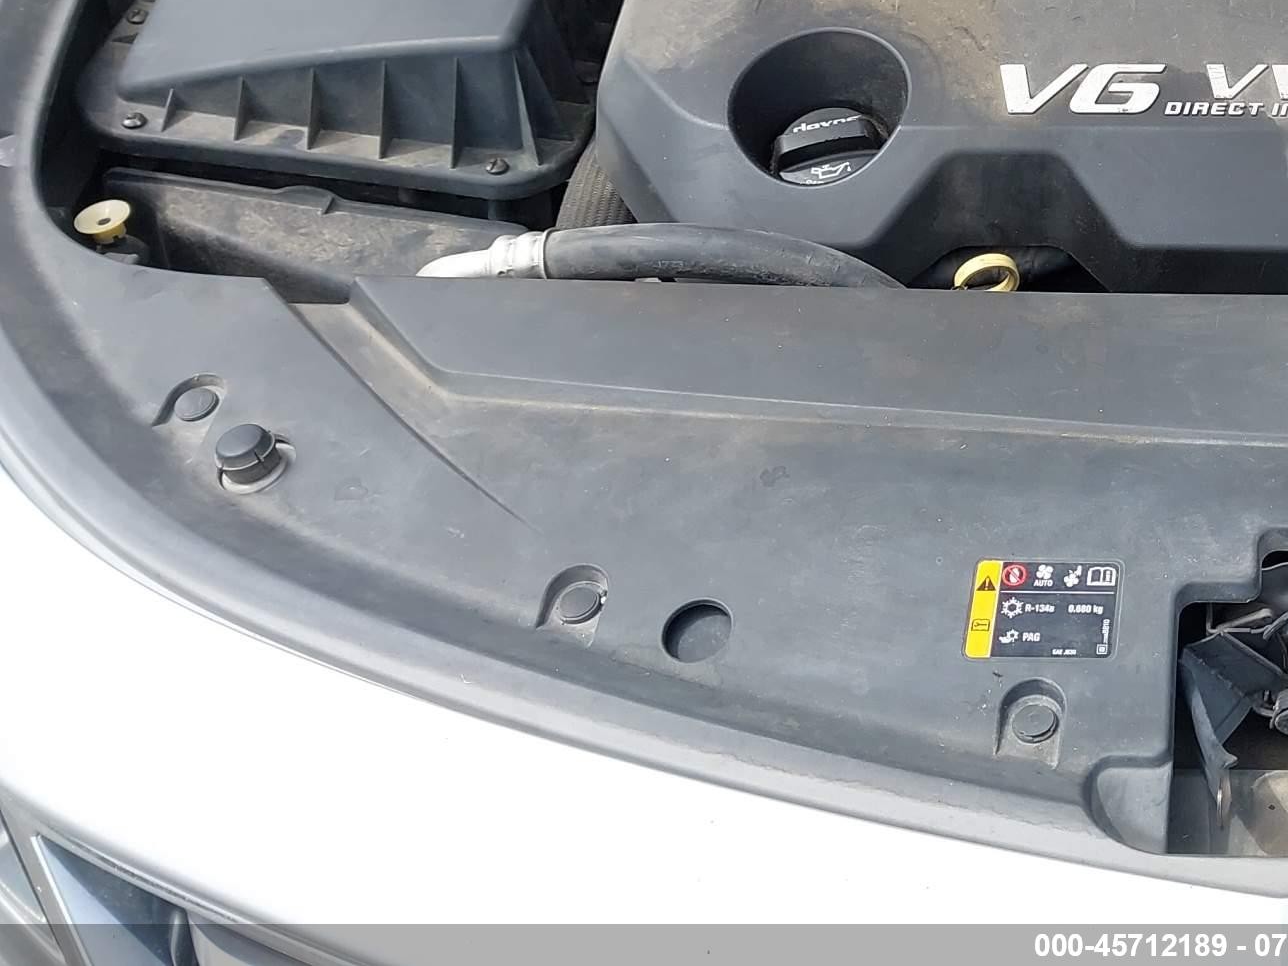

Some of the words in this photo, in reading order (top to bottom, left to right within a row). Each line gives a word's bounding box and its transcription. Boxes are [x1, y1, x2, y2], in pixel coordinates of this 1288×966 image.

[1000, 64, 1167, 114] V6
[1164, 101, 1265, 117] DIRECT
[1033, 579, 1054, 587] AUTO
[1024, 603, 1055, 613] R-134a
[1093, 604, 1104, 615] kg
[1022, 632, 1041, 642] PAG
